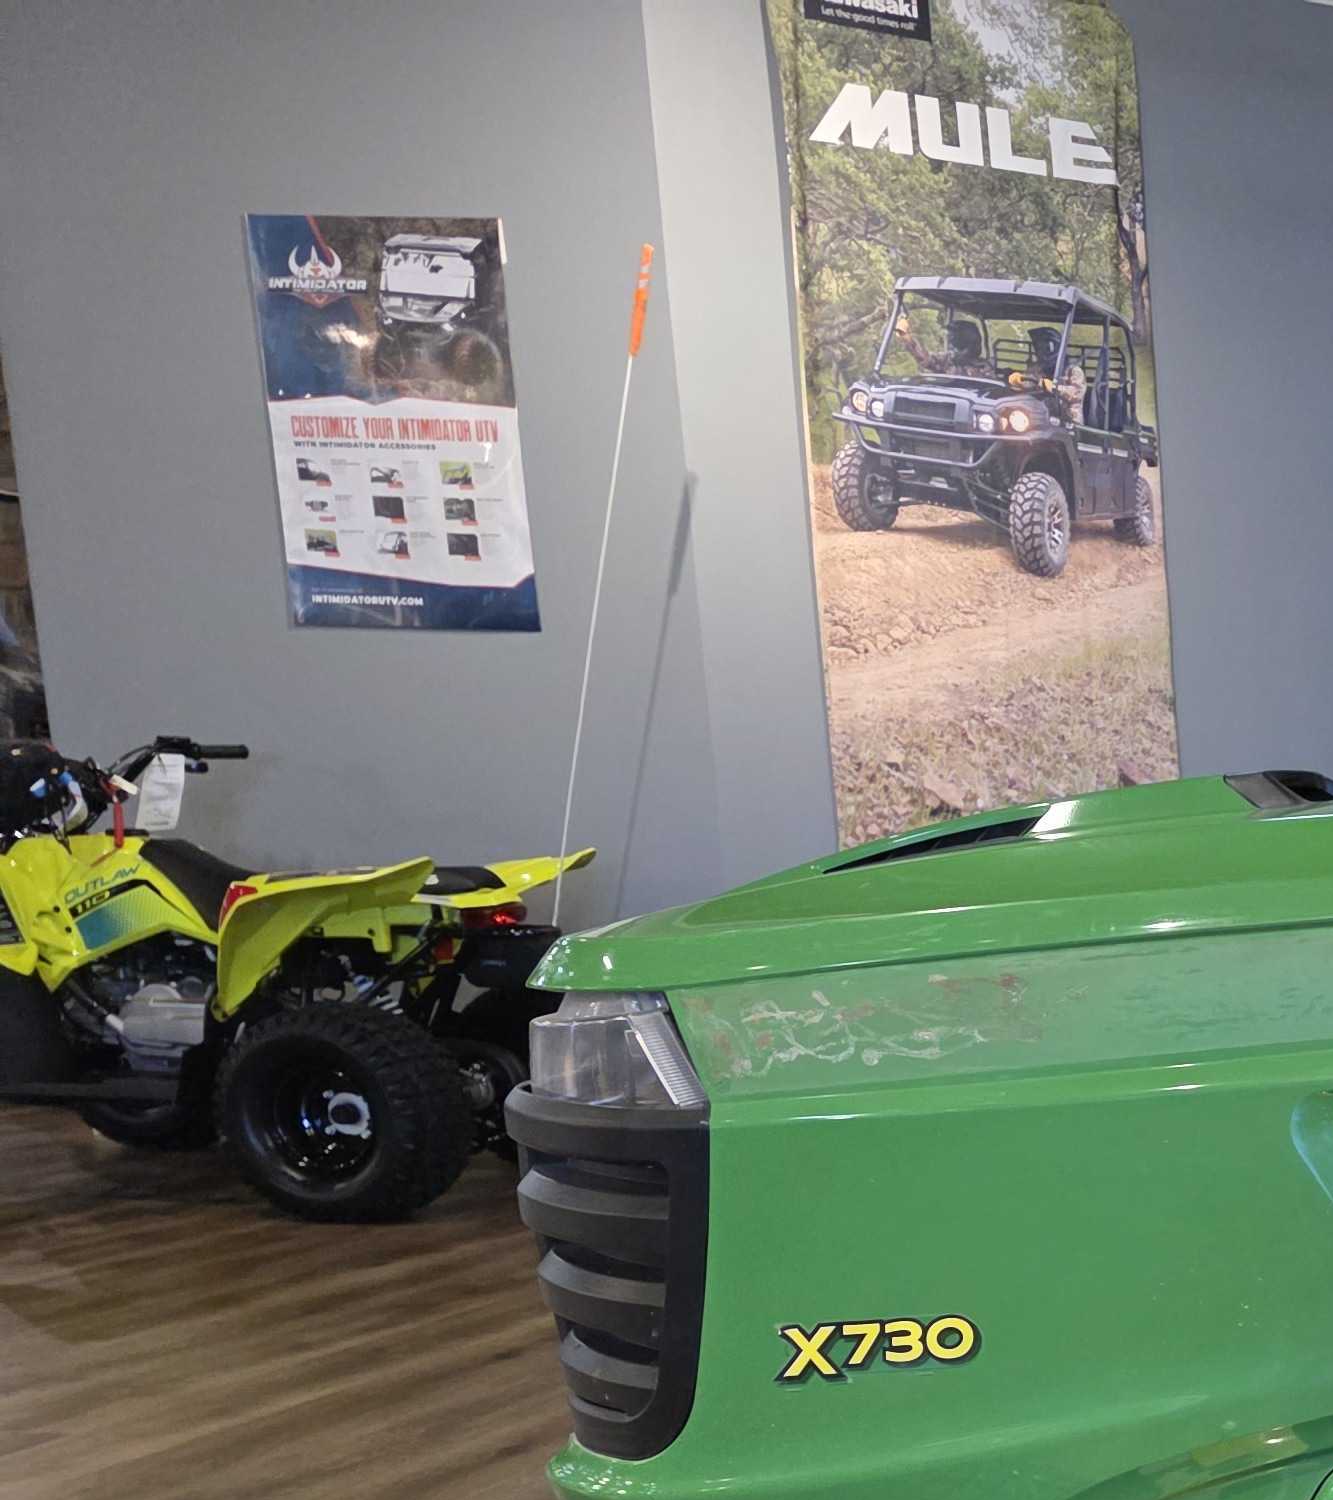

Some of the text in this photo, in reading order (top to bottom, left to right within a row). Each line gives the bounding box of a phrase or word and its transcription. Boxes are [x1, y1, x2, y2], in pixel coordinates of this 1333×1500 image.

[809, 82, 1120, 186] MULE
[268, 277, 367, 290] INTIMIDATOR
[291, 415, 498, 443] CUSTOMIZE YOUR INTIMIDATOR UTV
[775, 1315, 980, 1382] X730
